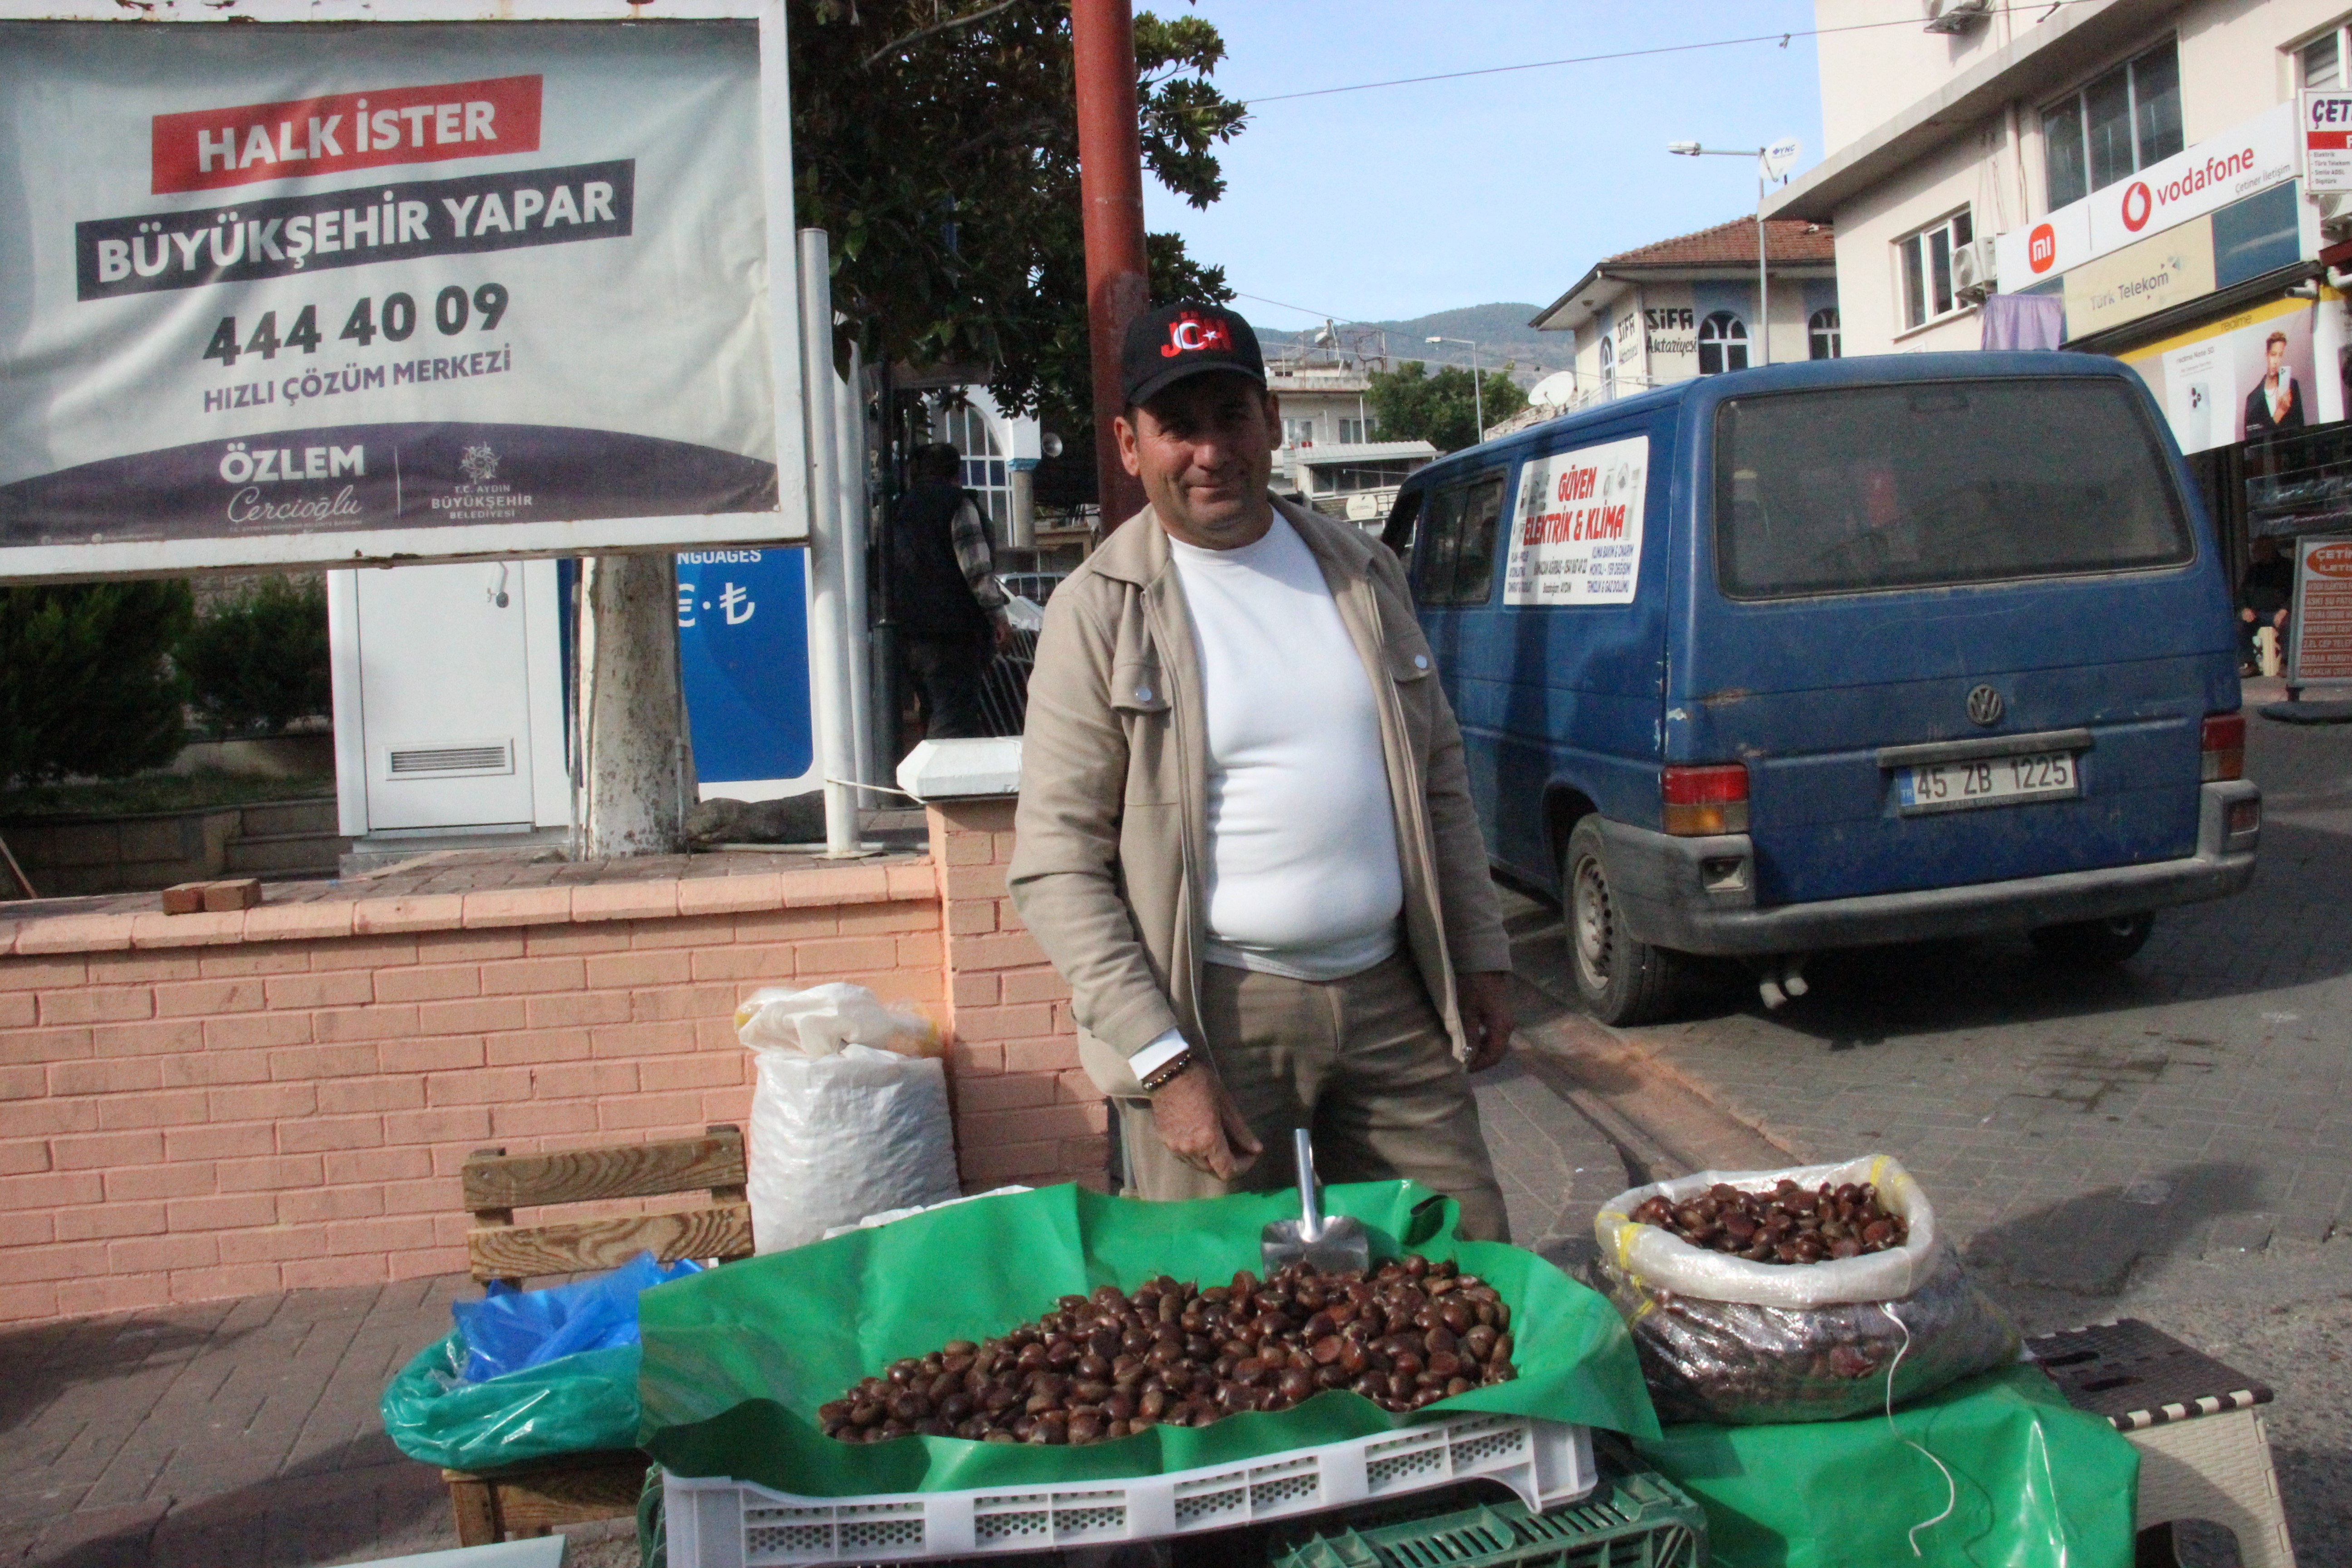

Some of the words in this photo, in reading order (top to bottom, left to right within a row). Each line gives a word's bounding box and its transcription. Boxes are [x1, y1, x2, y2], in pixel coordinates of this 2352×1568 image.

[2312, 99, 2352, 129] ÇET
[197, 115, 343, 173] HALK
[356, 99, 497, 153] İSTER
[2157, 148, 2254, 206] vodafone
[98, 191, 430, 283] BÜYÜKŞEHİR
[442, 181, 616, 238] YAPAR
[2091, 290, 2115, 310] Türk
[2118, 272, 2169, 300] Telekom
[203, 304, 322, 366] 444
[339, 292, 416, 346] 40
[436, 283, 509, 336] 09
[1645, 308, 1693, 332] ŞİFA
[2221, 315, 2252, 331] realme
[1646, 336, 1697, 358] Aktariyesi
[204, 381, 274, 412] HIZLI
[282, 363, 385, 406] ÇÖZÜM
[393, 343, 511, 385] MERKEZİ
[220, 442, 364, 483] ÖZLEM
[431, 493, 532, 509] BÜYÜKŞEHİR
[477, 485, 510, 493] AYDIN
[1558, 465, 1597, 502] GÜVEN
[450, 509, 515, 519] BELEDİYESİ
[1585, 500, 1625, 541] KLİMA
[1901, 789, 1913, 798] TR
[1918, 767, 1947, 799] 45
[1961, 762, 1992, 795] ZB
[2010, 755, 2067, 789] 1225
